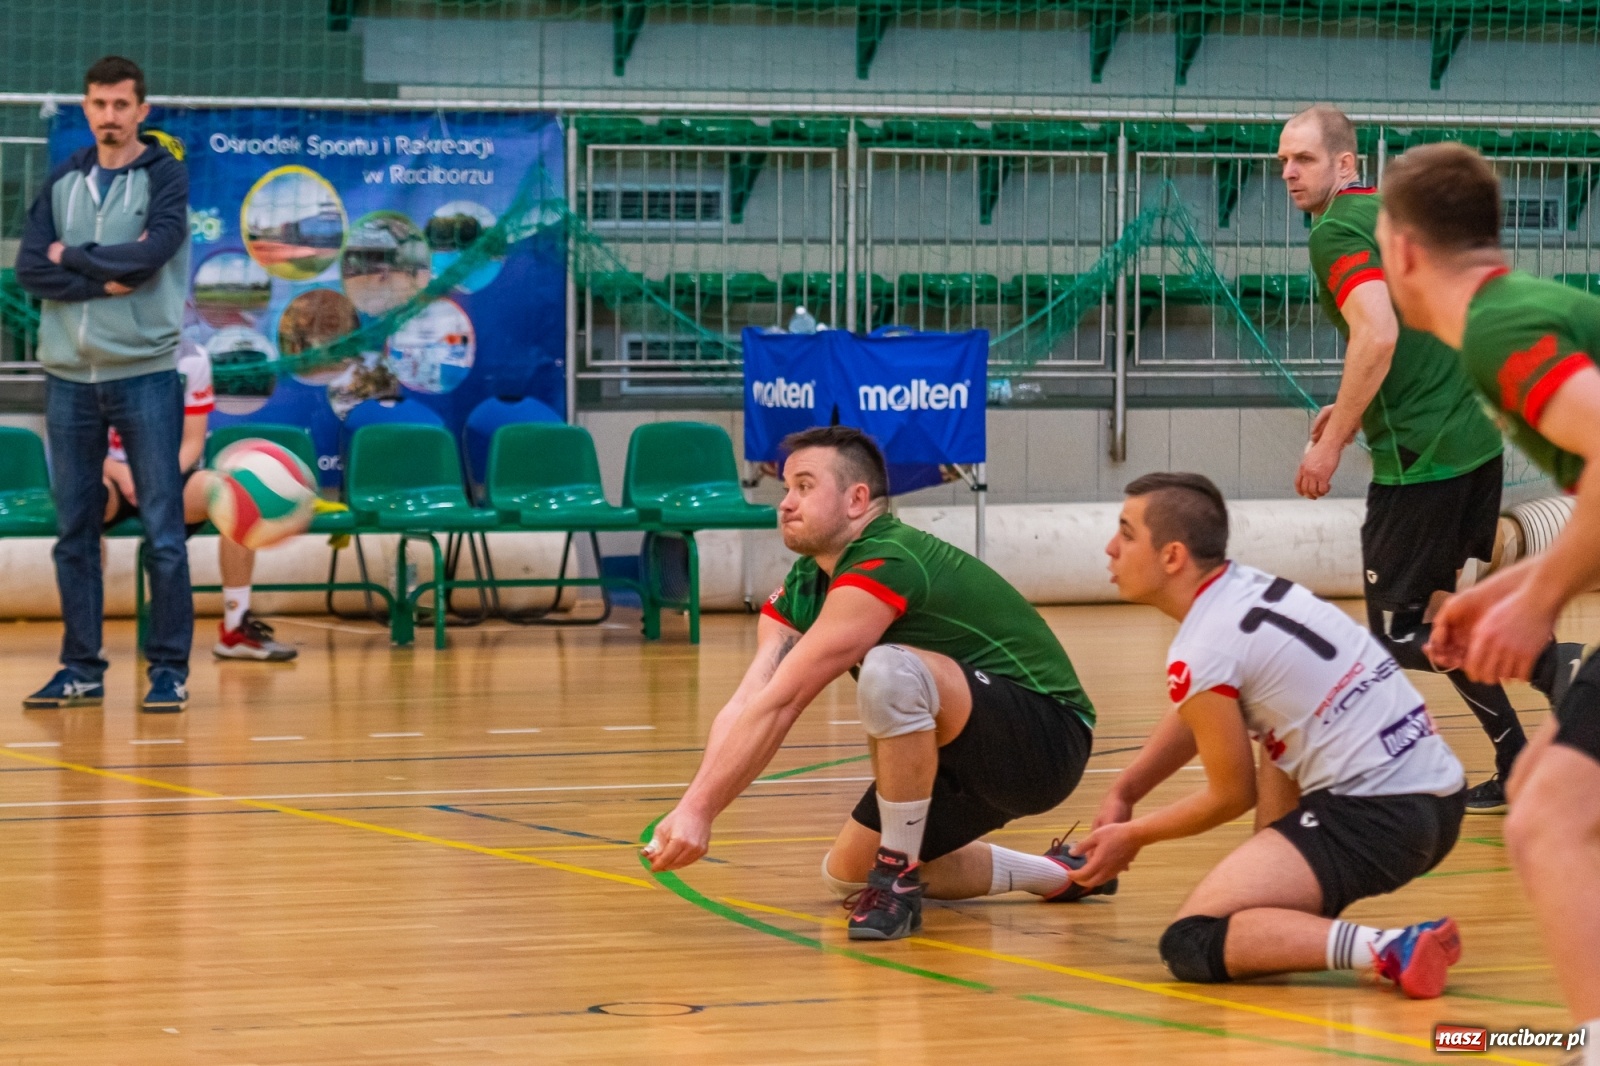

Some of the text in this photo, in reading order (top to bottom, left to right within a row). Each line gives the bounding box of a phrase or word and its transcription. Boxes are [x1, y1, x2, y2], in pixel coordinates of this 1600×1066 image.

[306, 134, 378, 160] Sportu
[383, 136, 391, 155] i
[395, 135, 495, 160] Rekreacji
[362, 164, 495, 185] w Raciborzu
[752, 377, 816, 410] molten
[858, 378, 970, 412] molten
